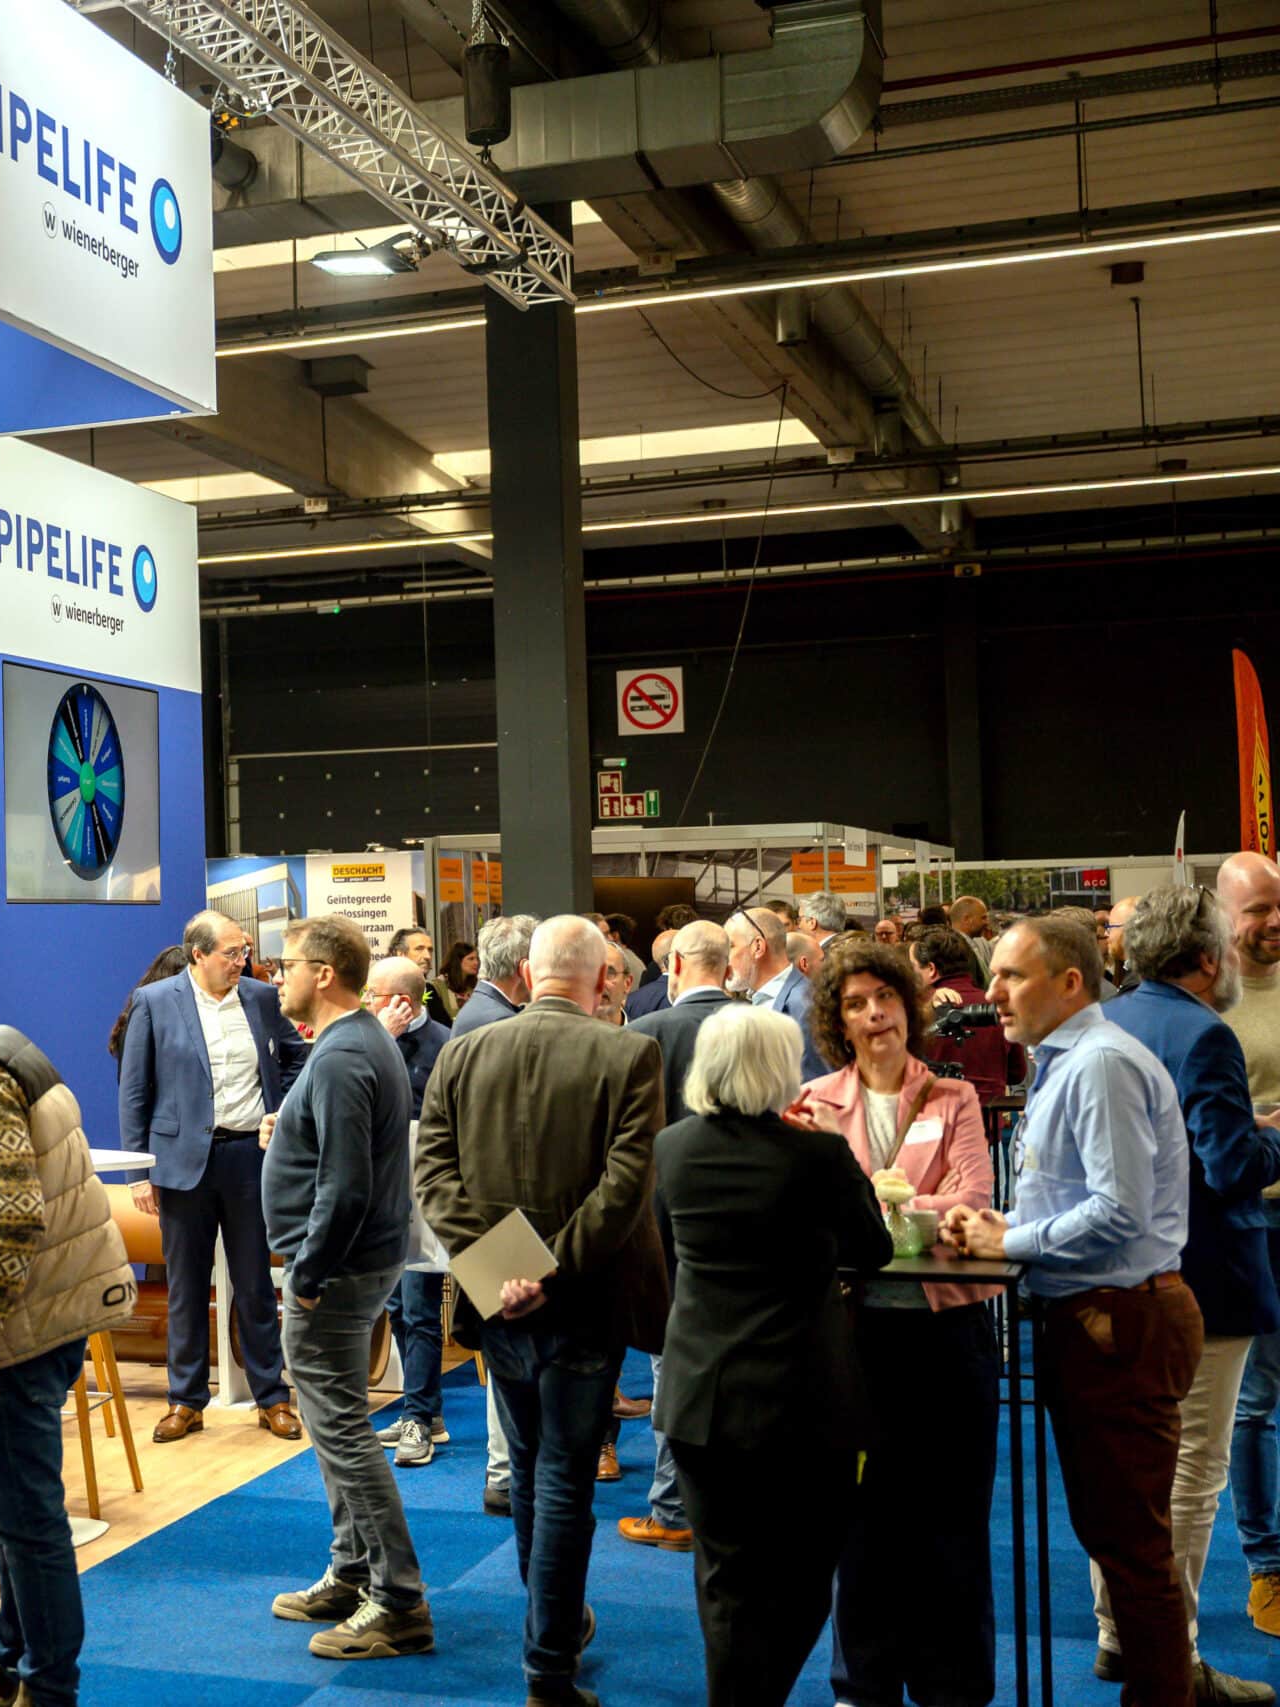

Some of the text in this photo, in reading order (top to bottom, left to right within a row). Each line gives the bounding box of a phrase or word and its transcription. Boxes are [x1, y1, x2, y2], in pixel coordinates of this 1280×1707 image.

[61, 219, 139, 278] wienerberger
[65, 602, 124, 636] wienerberger
[333, 866, 383, 876] DESCHACHT
[1083, 879, 1107, 887] ACO
[331, 907, 387, 919] lossingen
